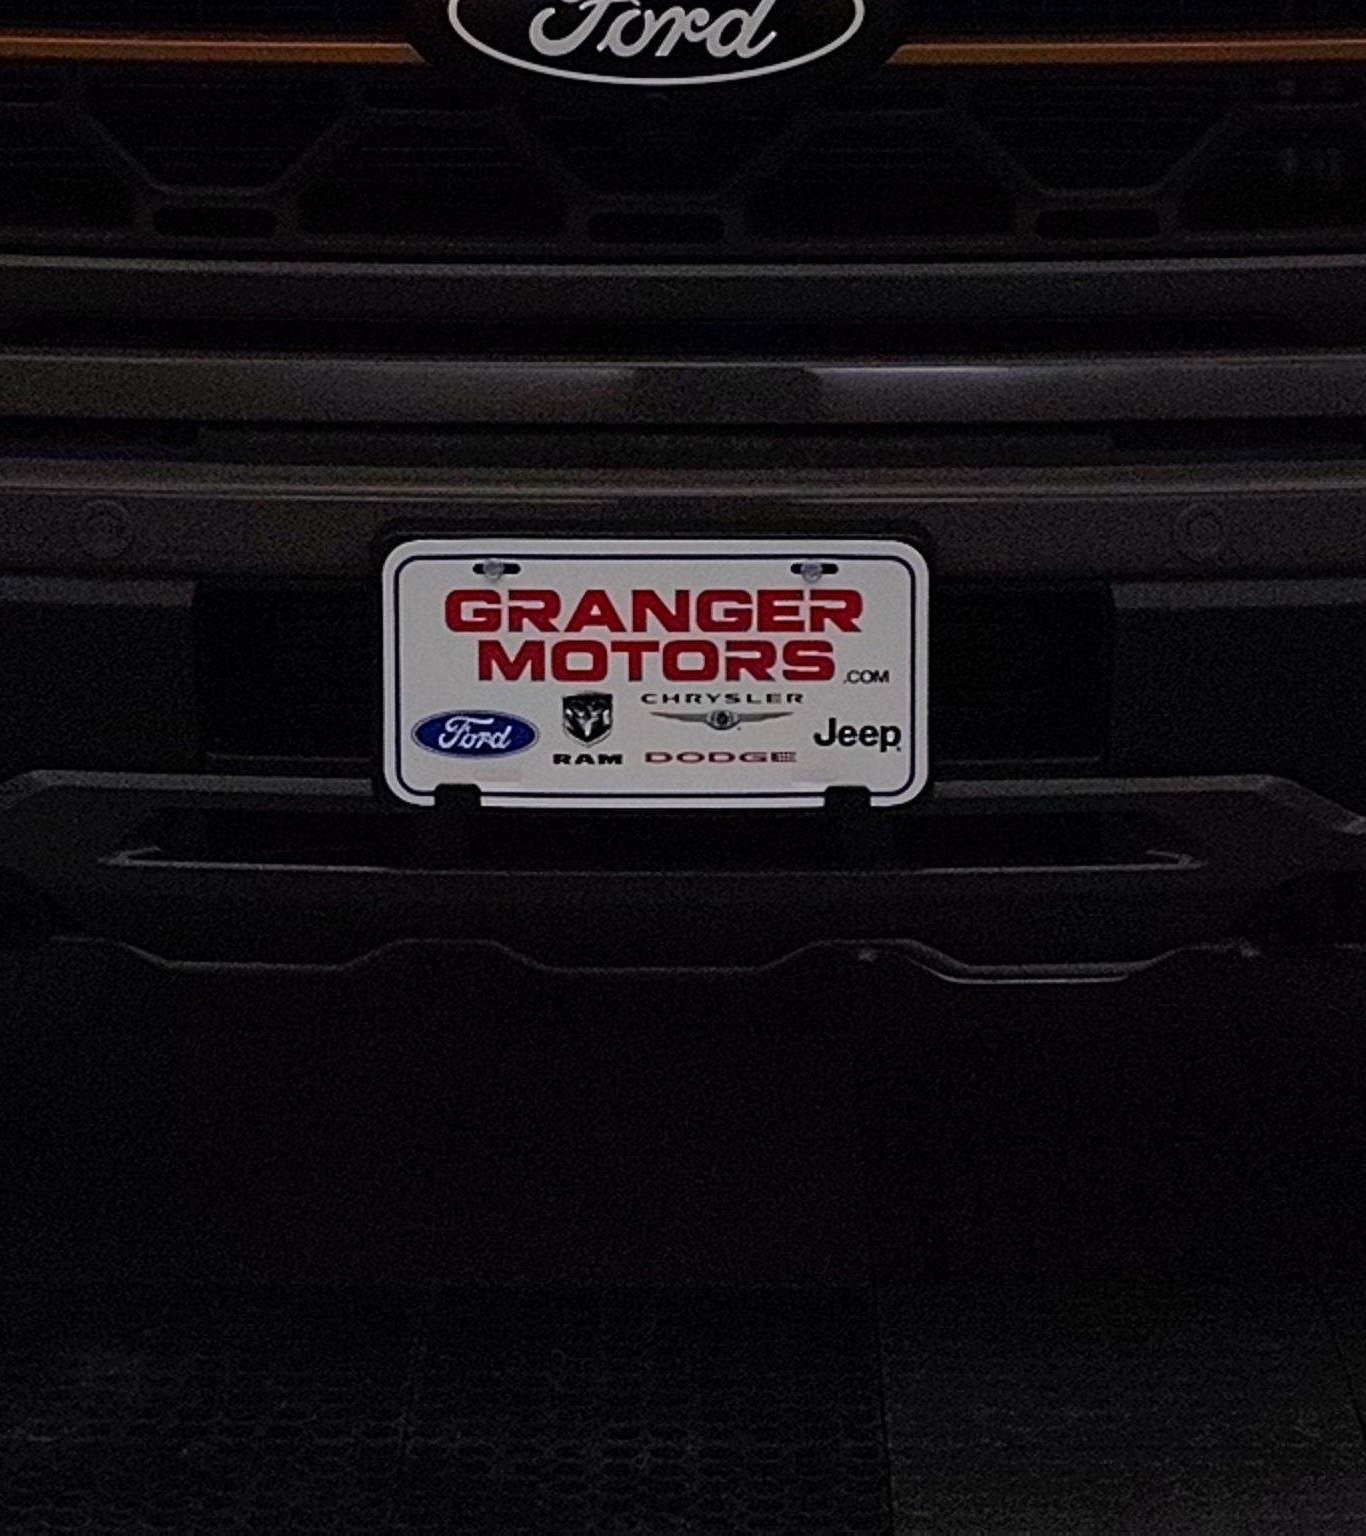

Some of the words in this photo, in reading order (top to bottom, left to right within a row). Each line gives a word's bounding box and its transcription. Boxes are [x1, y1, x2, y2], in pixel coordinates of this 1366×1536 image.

[443, 588, 865, 633] GRANGER
[477, 639, 837, 683] MOTORS
[843, 669, 891, 684] .COM
[640, 692, 806, 705] CHRYSLER
[437, 715, 513, 751] Ford
[813, 718, 902, 752] Jeep
[552, 753, 624, 765] RAM
[644, 751, 798, 764] DODGE
